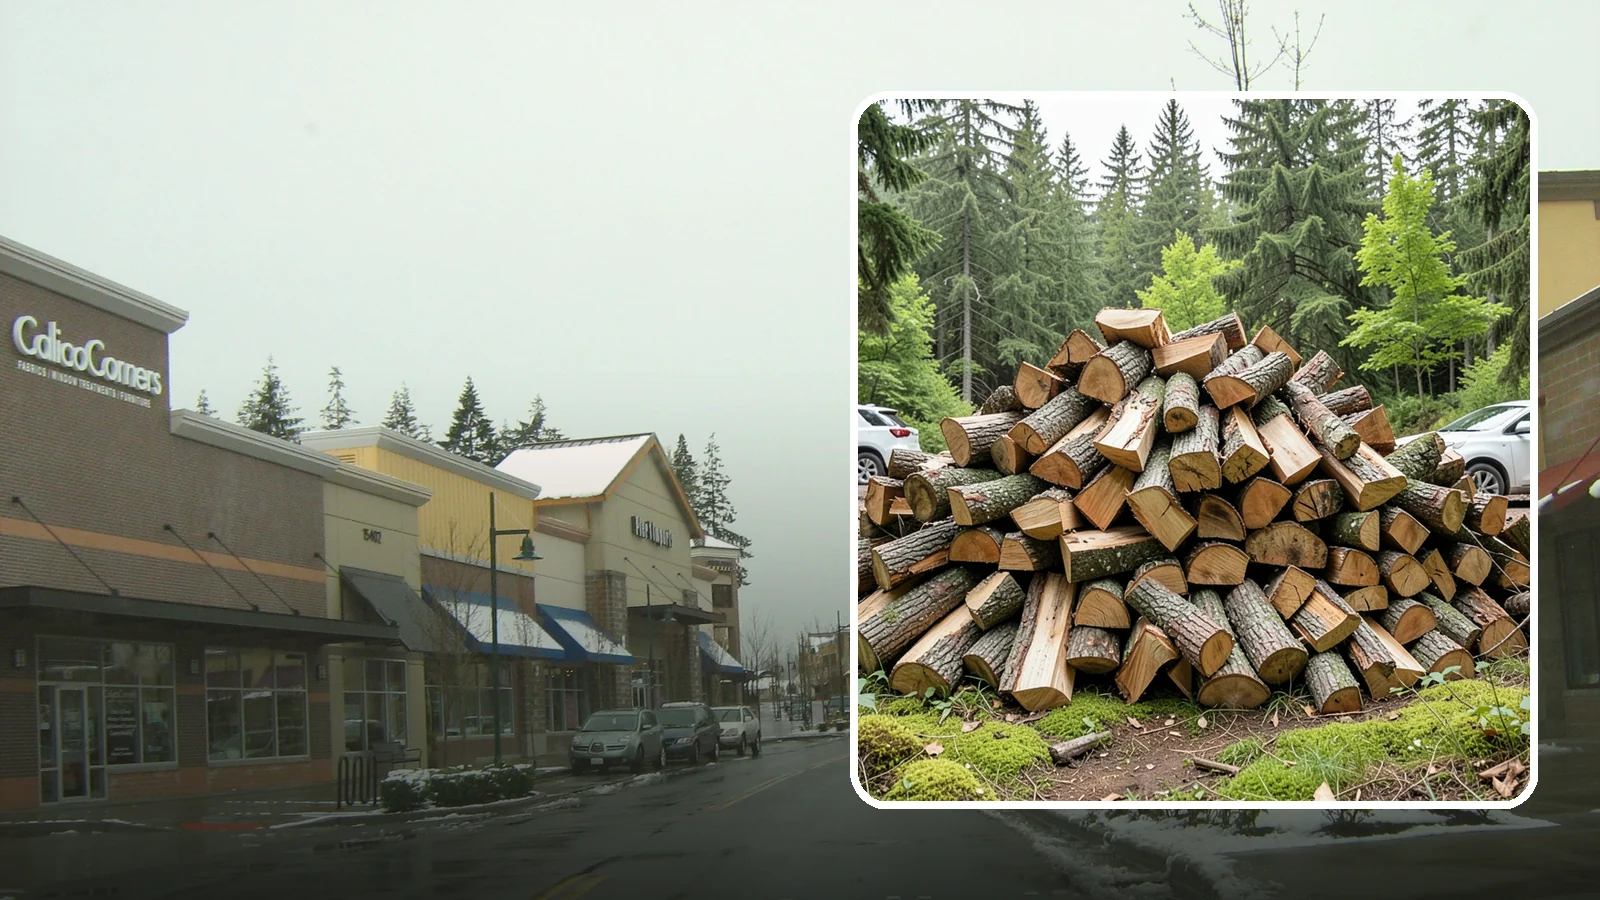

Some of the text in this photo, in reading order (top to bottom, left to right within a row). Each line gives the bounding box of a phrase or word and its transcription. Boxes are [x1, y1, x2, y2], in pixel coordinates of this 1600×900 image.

[16, 359, 151, 408] FABRICS WINDOW TREATMENTS FURNITURE
